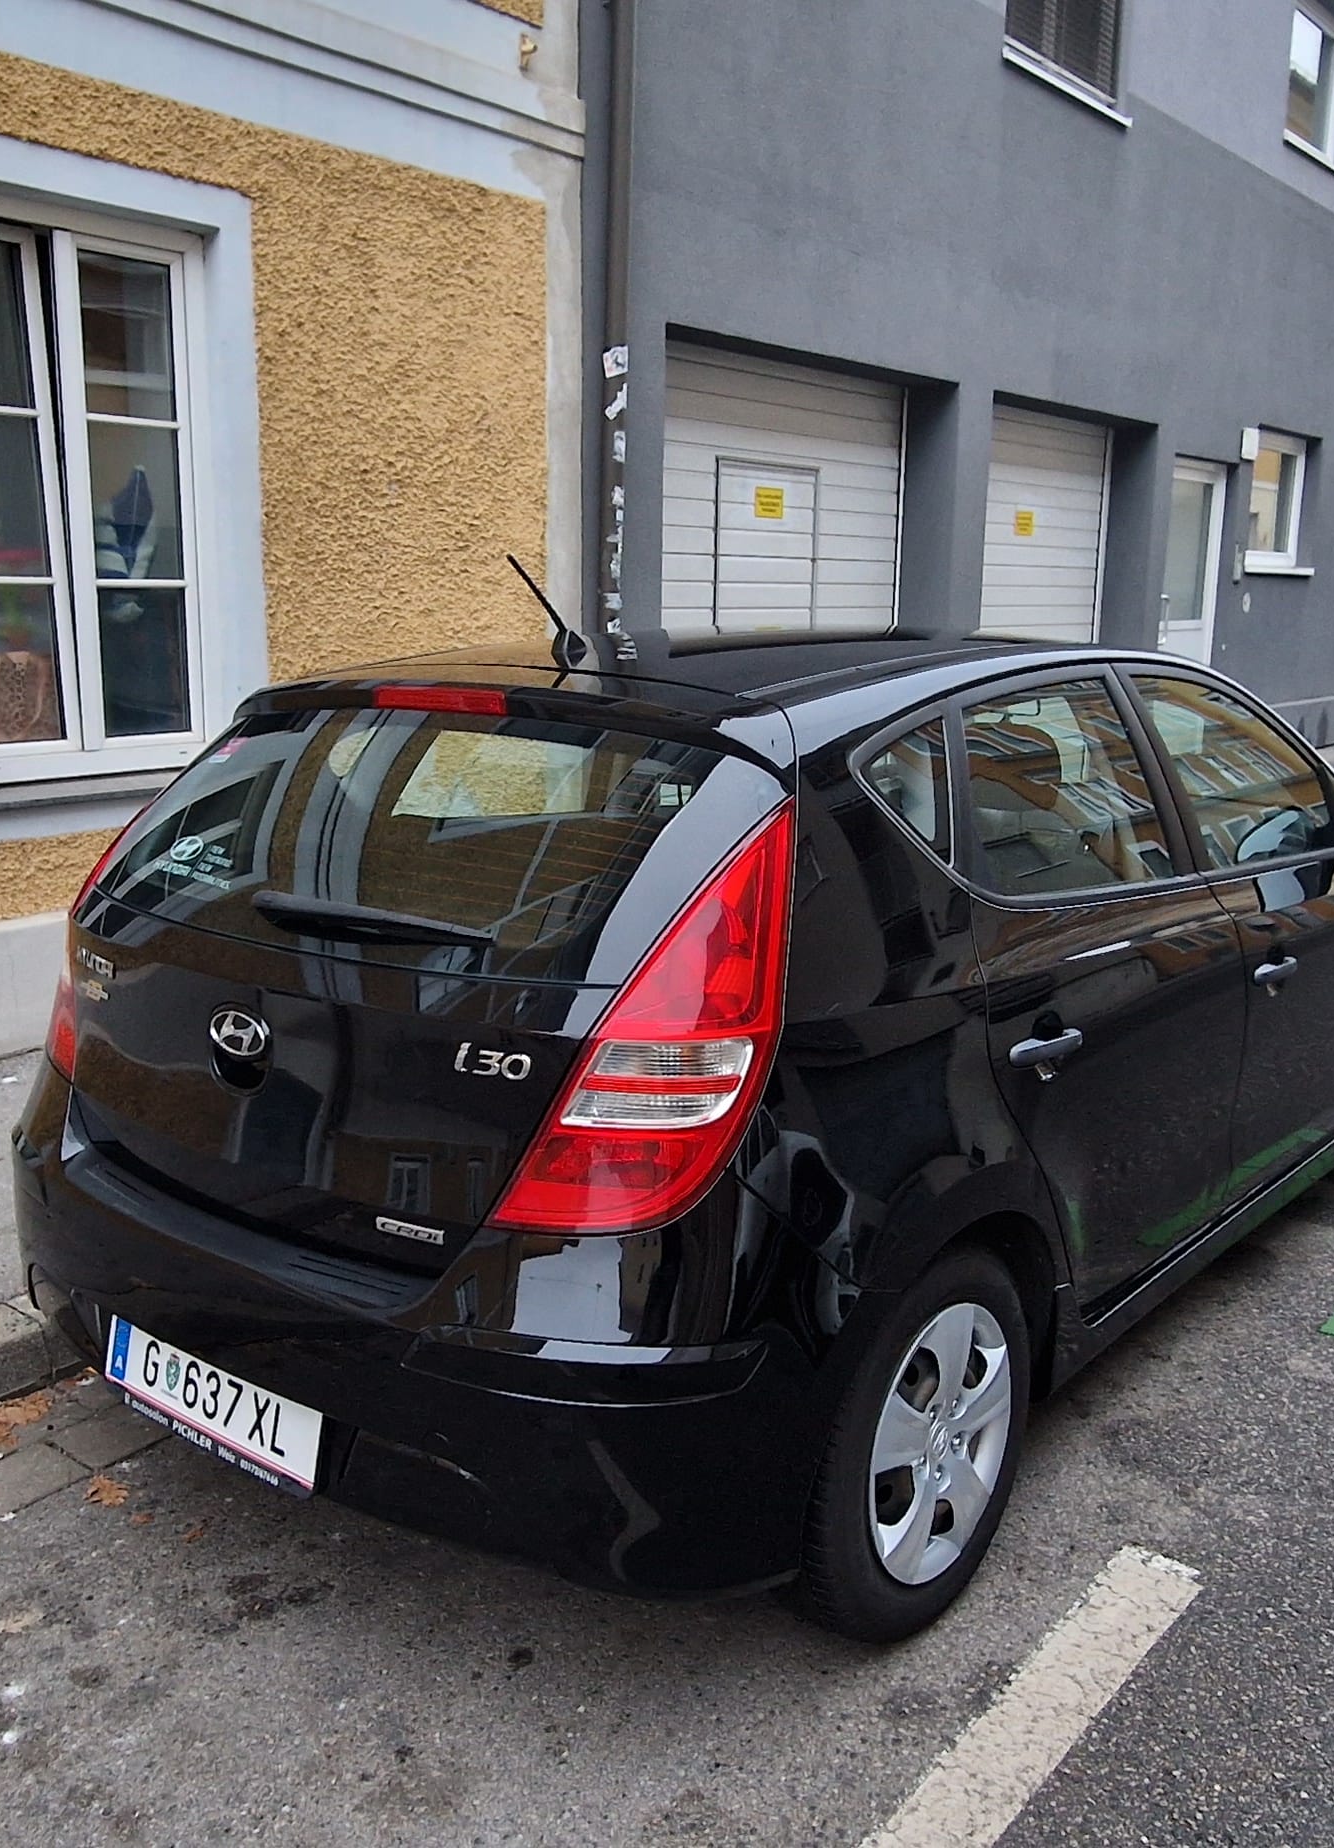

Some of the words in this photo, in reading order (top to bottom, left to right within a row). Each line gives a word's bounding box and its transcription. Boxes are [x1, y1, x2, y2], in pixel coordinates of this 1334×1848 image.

[114, 1354, 124, 1371] A
[143, 1339, 160, 1388] G
[182, 1360, 243, 1428] 637
[248, 1391, 286, 1458] XL
[171, 1419, 212, 1451] PICHLER
